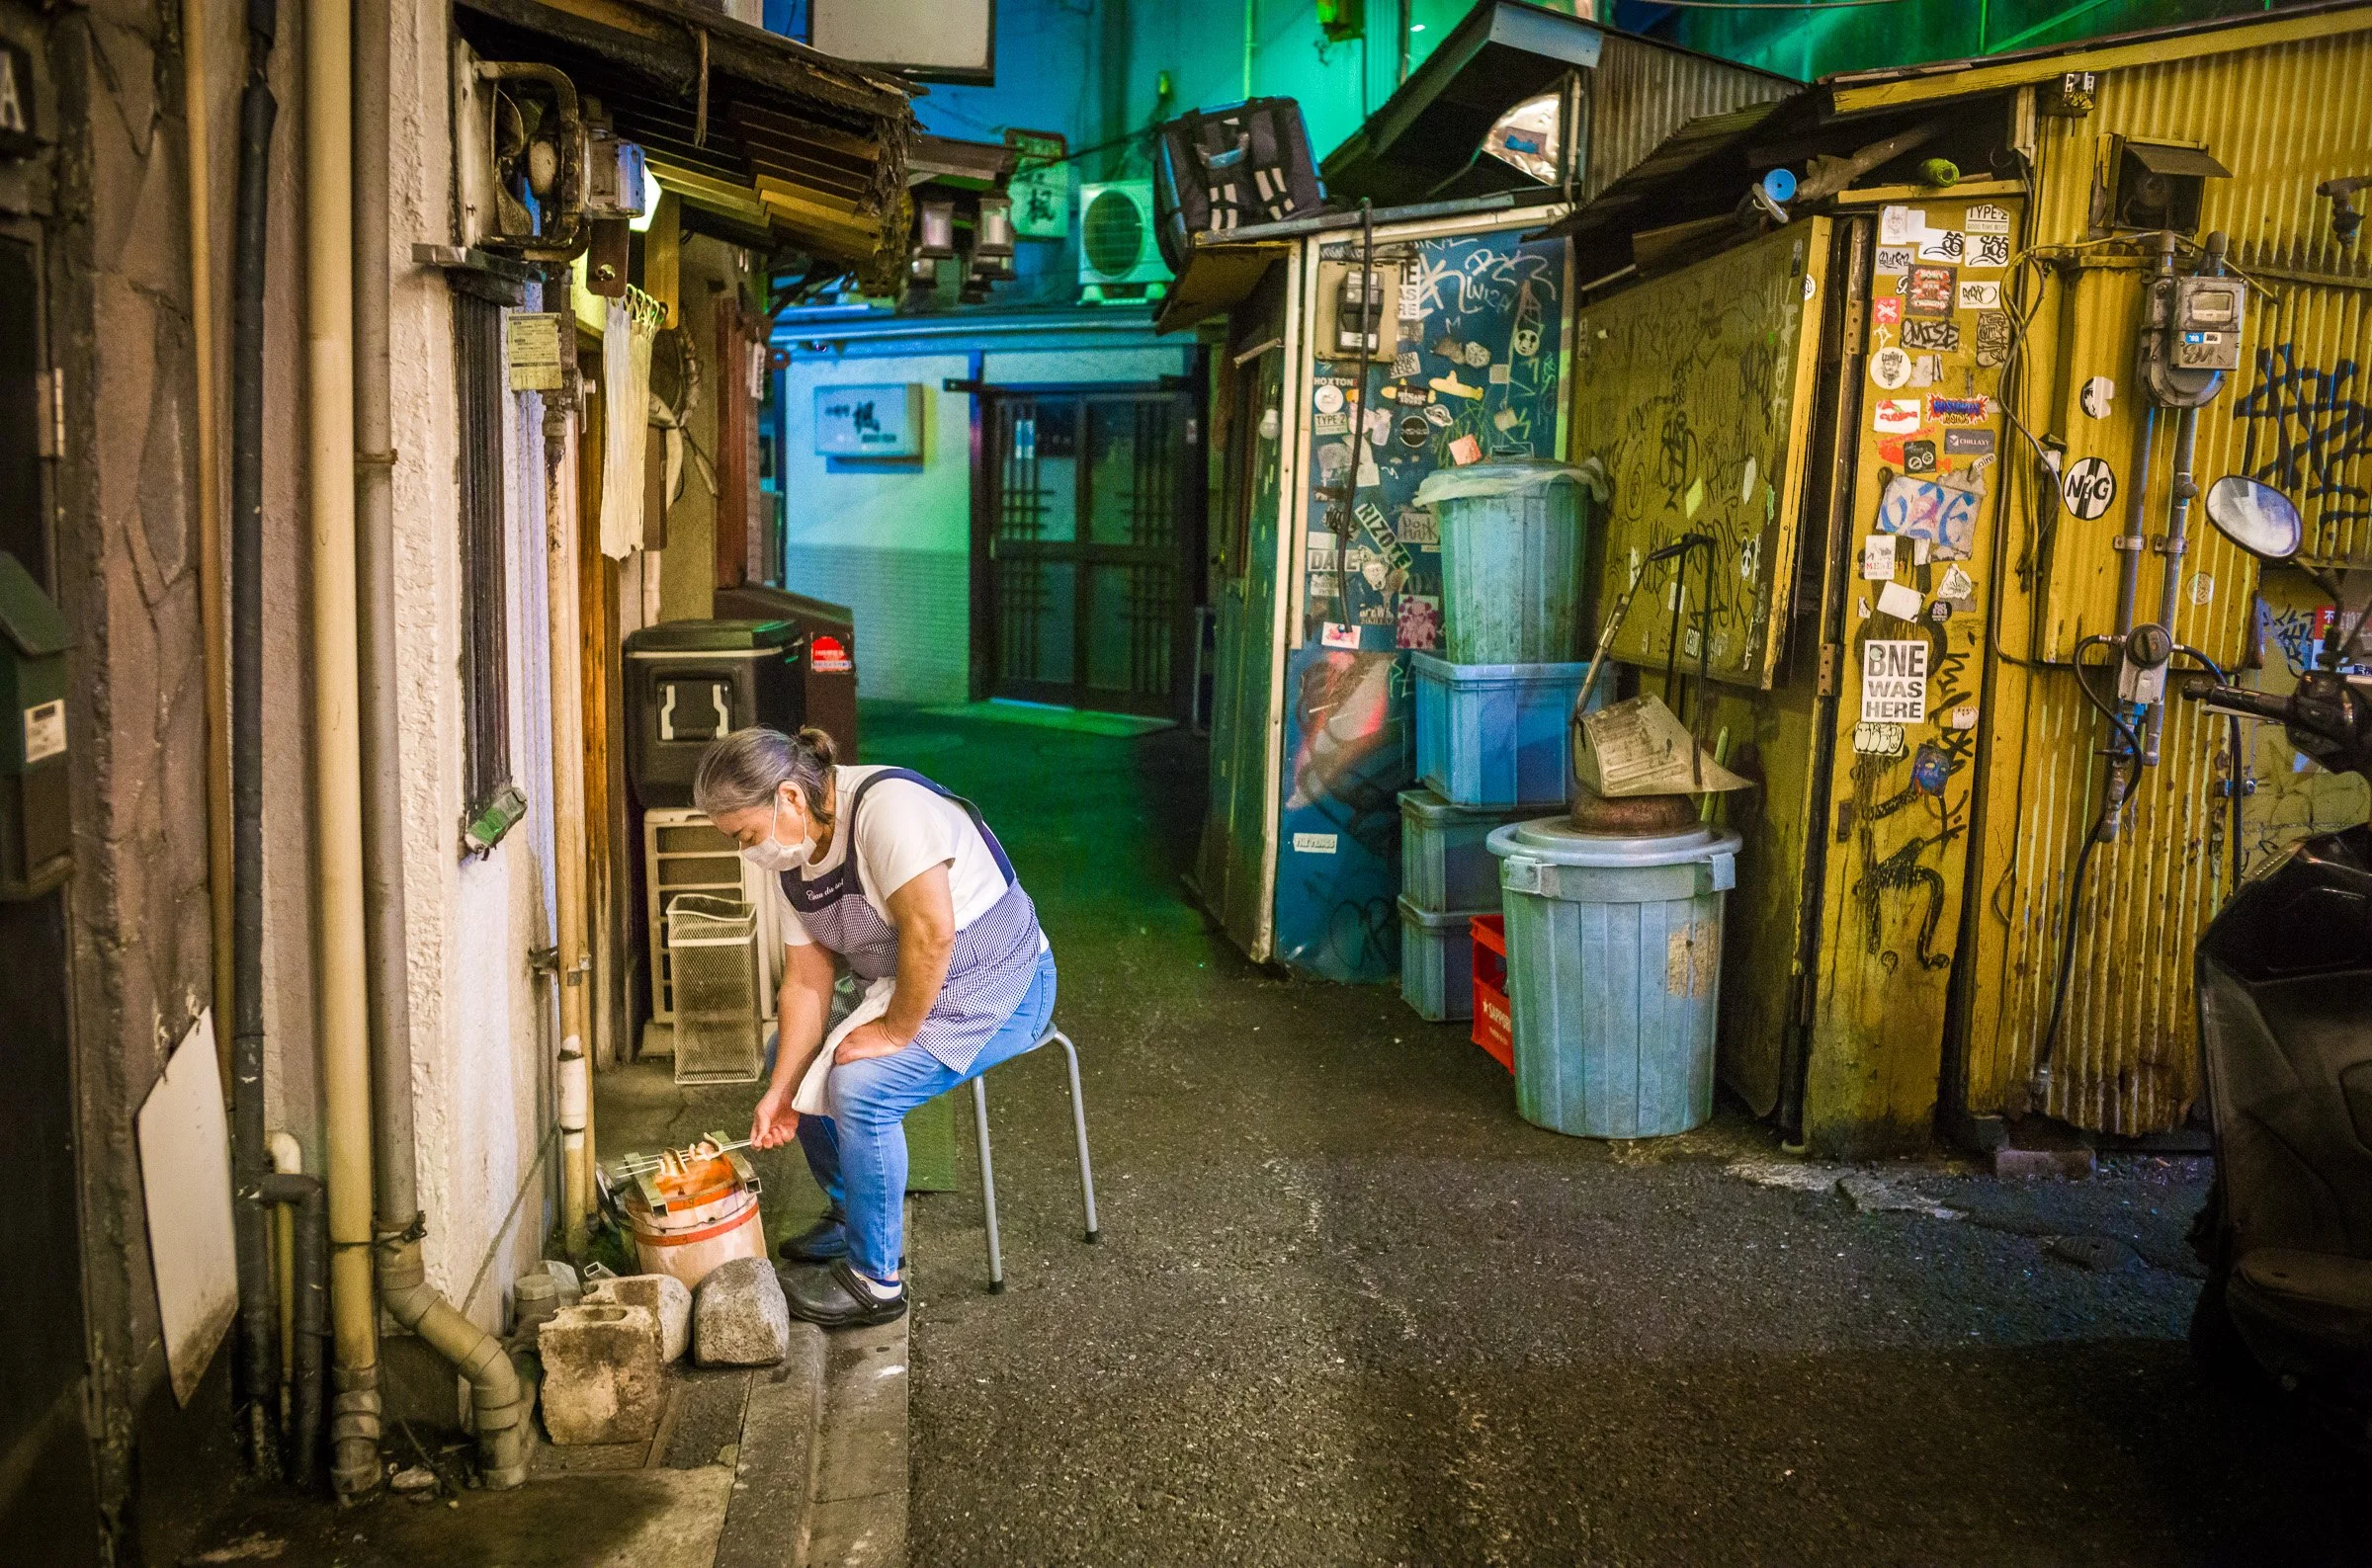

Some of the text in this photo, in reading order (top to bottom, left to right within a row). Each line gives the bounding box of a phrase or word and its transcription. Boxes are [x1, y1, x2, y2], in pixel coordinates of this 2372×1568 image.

[1316, 415, 1337, 425] TYPE
[1868, 644, 1925, 678] BNE
[1867, 681, 1923, 698] WAS
[1865, 701, 1922, 718] HERE
